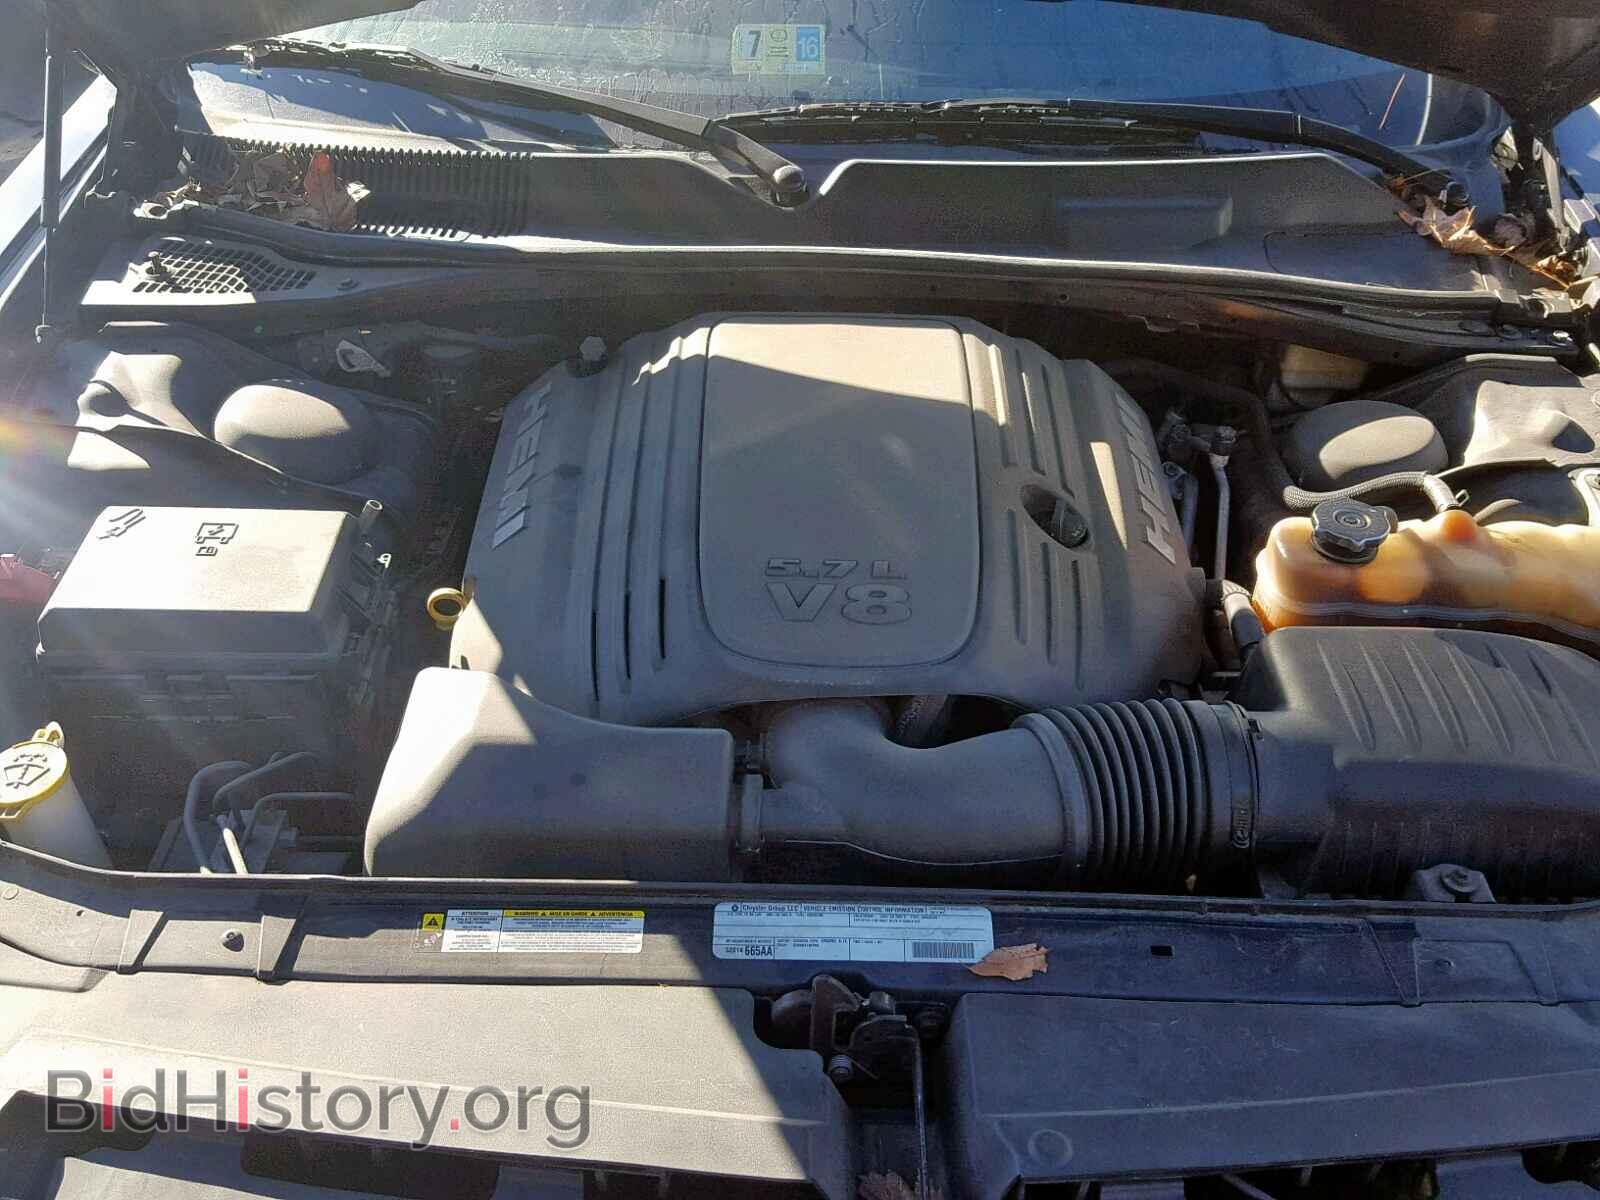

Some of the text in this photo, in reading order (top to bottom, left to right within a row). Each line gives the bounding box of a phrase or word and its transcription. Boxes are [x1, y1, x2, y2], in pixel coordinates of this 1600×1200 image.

[748, 30, 761, 58] 7
[798, 36, 819, 59] 16
[1114, 391, 1177, 565] HEMI
[765, 582, 913, 626] V8
[742, 904, 766, 913] Chrysler
[787, 904, 799, 912] LLC
[803, 904, 828, 912] VEHICLE
[829, 904, 856, 913] EMISSION
[857, 905, 883, 913] CONTROL
[884, 905, 925, 914] INFORMATION
[744, 945, 773, 956] 665AA
